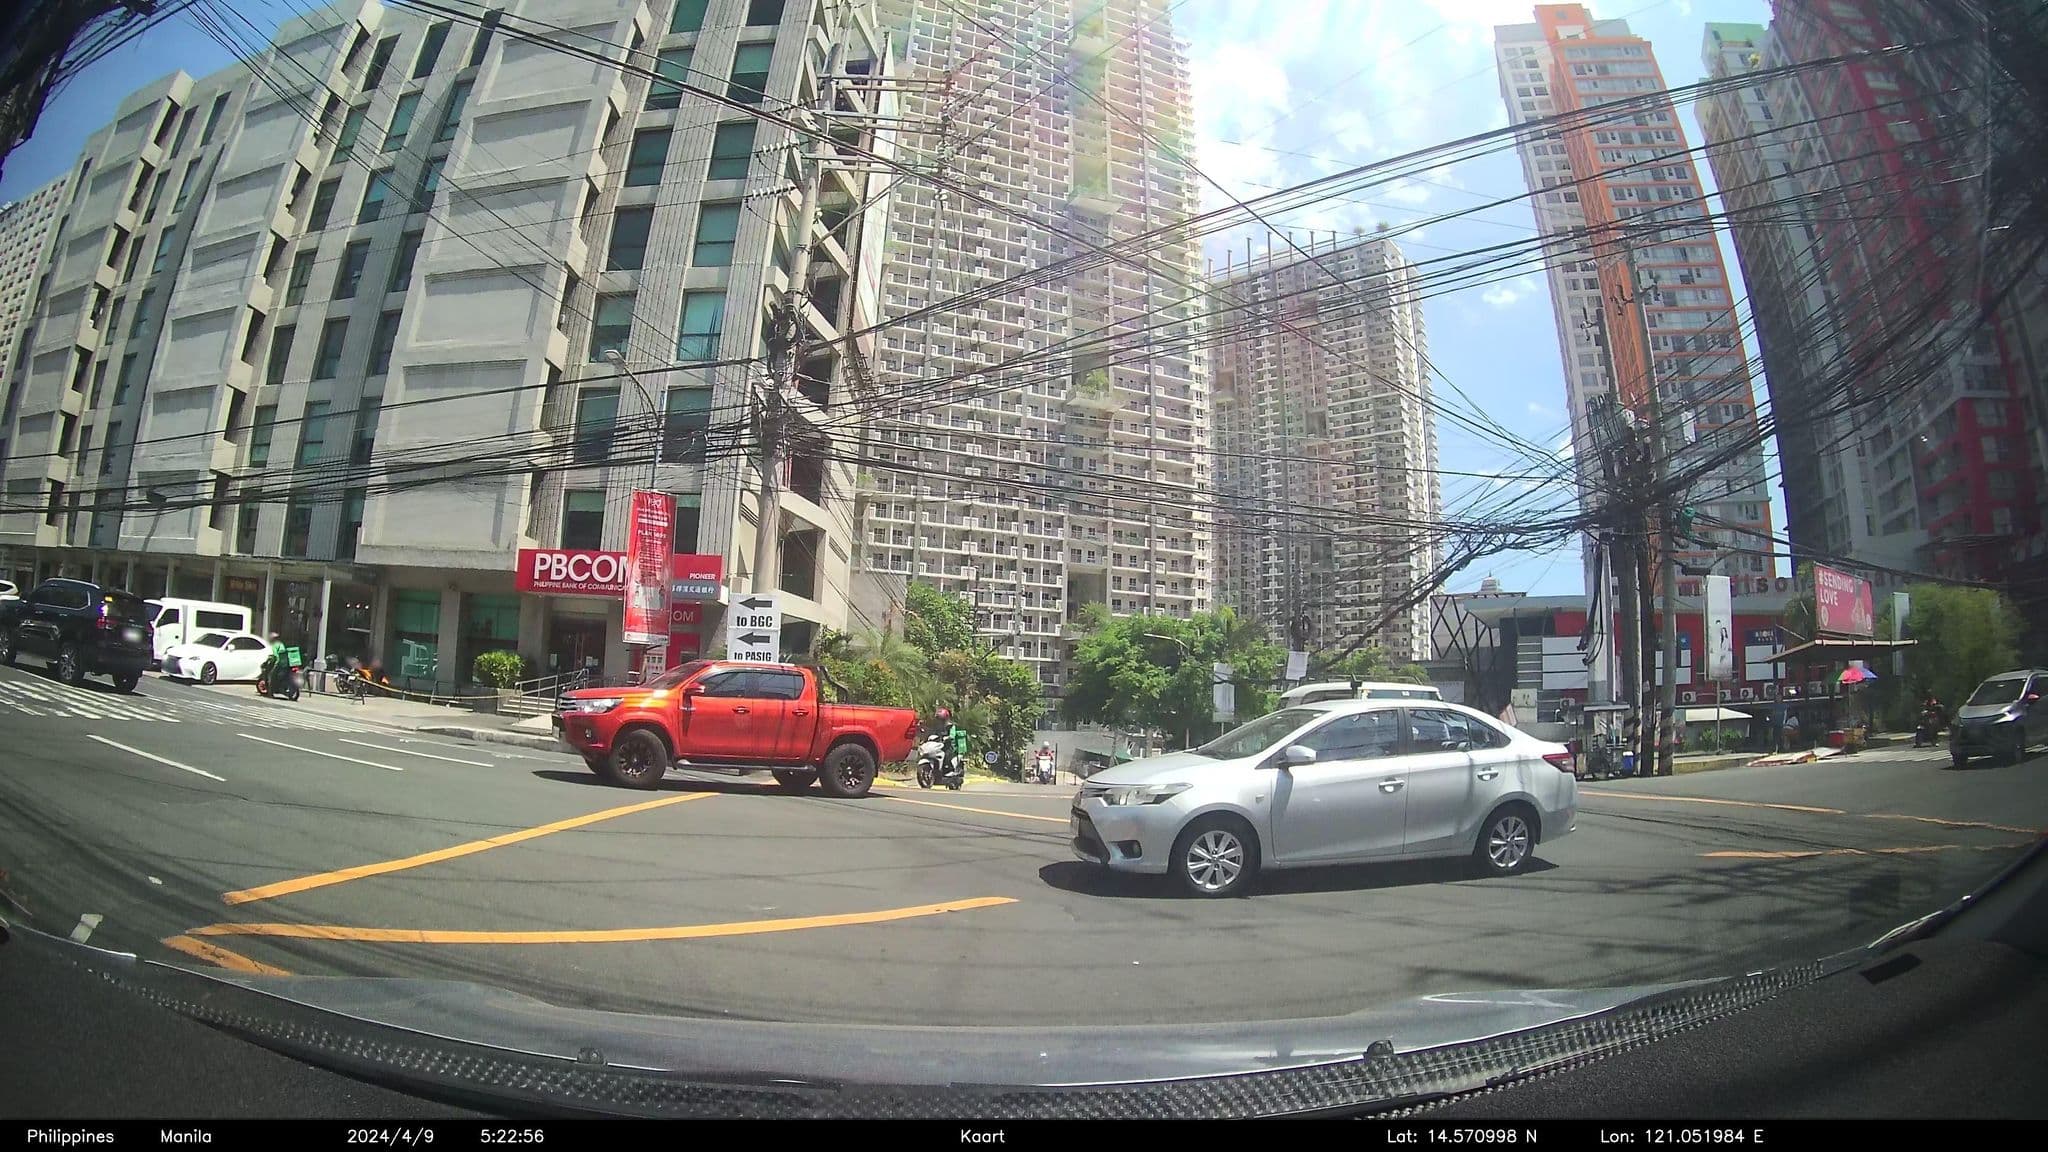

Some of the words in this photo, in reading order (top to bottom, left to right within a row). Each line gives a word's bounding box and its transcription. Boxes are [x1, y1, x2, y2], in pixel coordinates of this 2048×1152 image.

[689, 572, 716, 580] PIONEER
[587, 583, 628, 592] COMMUNICA
[1818, 572, 1854, 593] #SENDING
[1820, 589, 1839, 606] LOVE
[737, 616, 747, 627] to
[750, 615, 773, 628] BGC
[734, 652, 743, 660] to
[745, 651, 772, 662] PASIG
